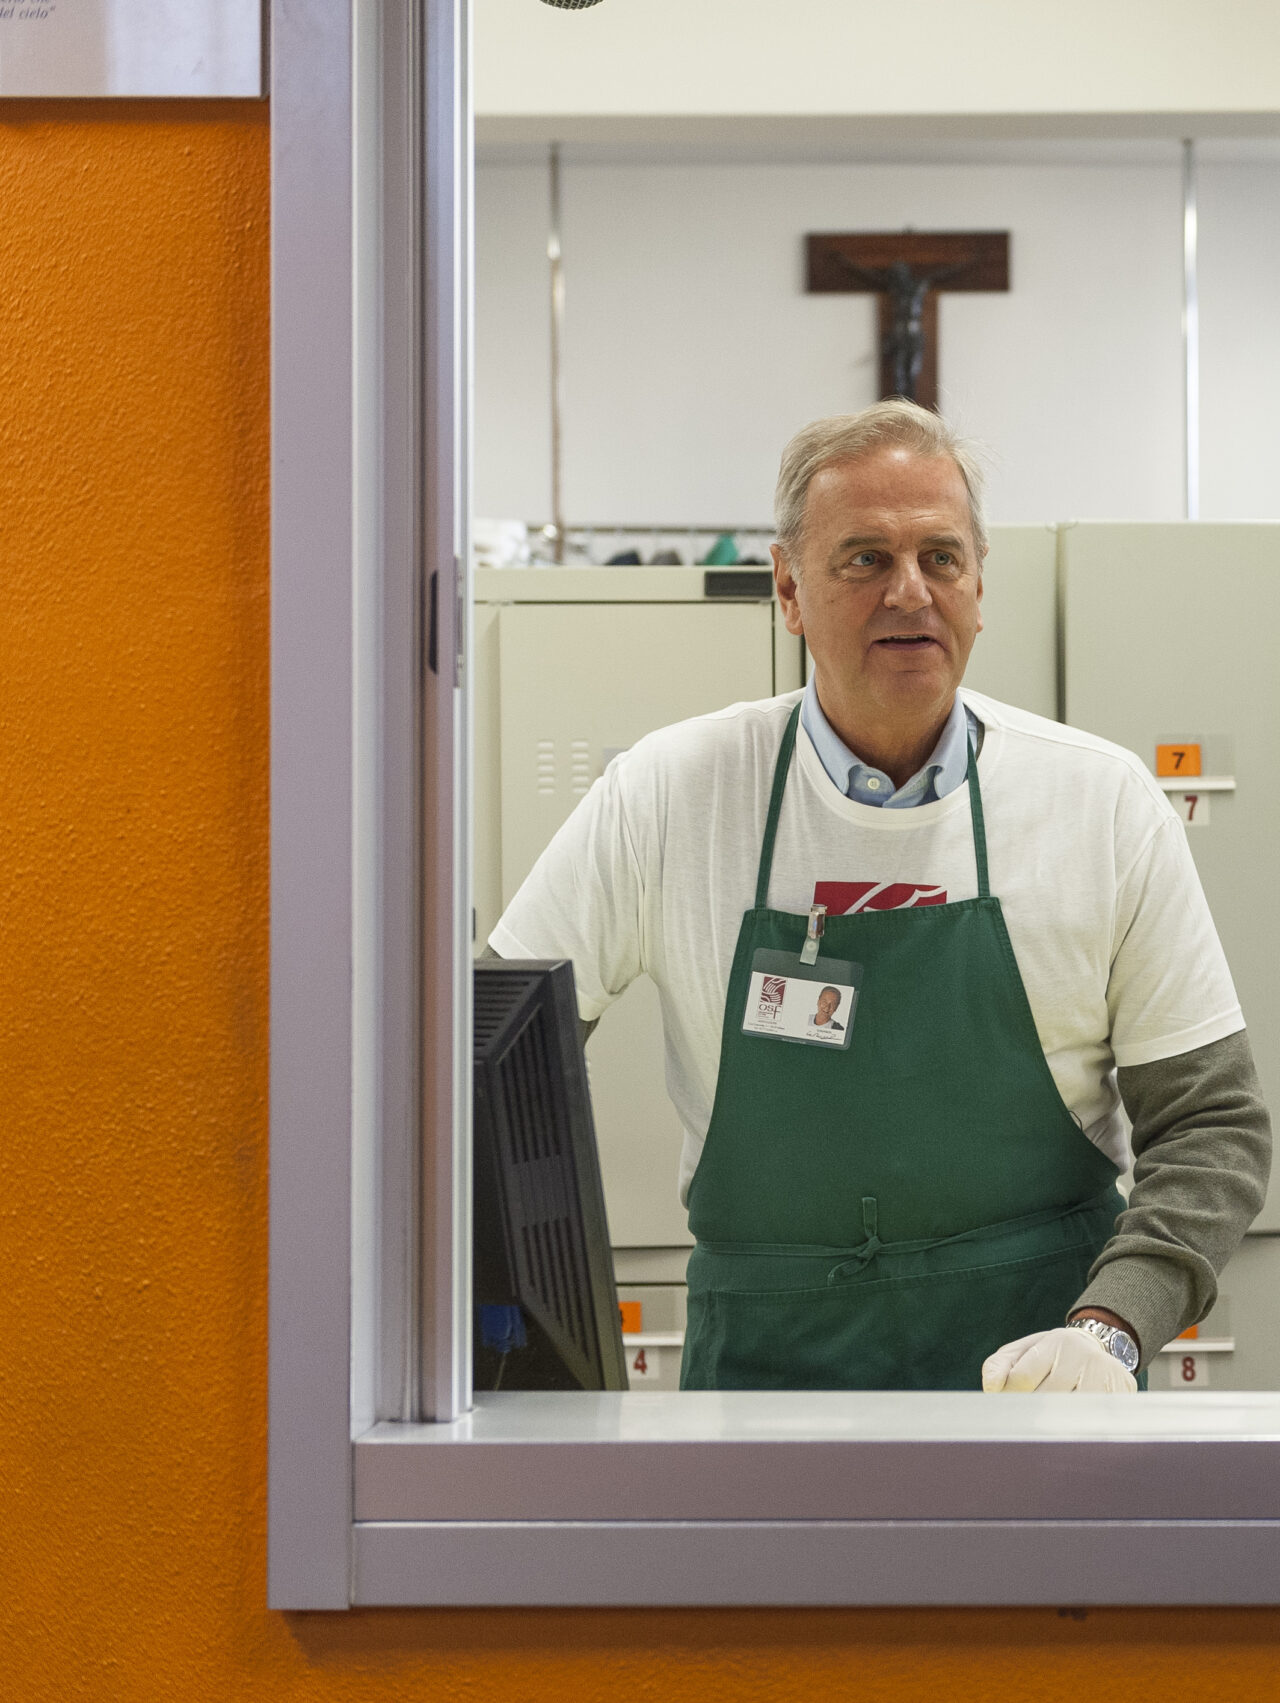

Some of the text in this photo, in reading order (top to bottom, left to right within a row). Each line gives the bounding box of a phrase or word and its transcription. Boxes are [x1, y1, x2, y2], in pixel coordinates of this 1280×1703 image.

[1172, 752, 1185, 770] 7
[1184, 795, 1198, 821] 7
[633, 1349, 647, 1375] 4
[1182, 1356, 1195, 1382] 8
